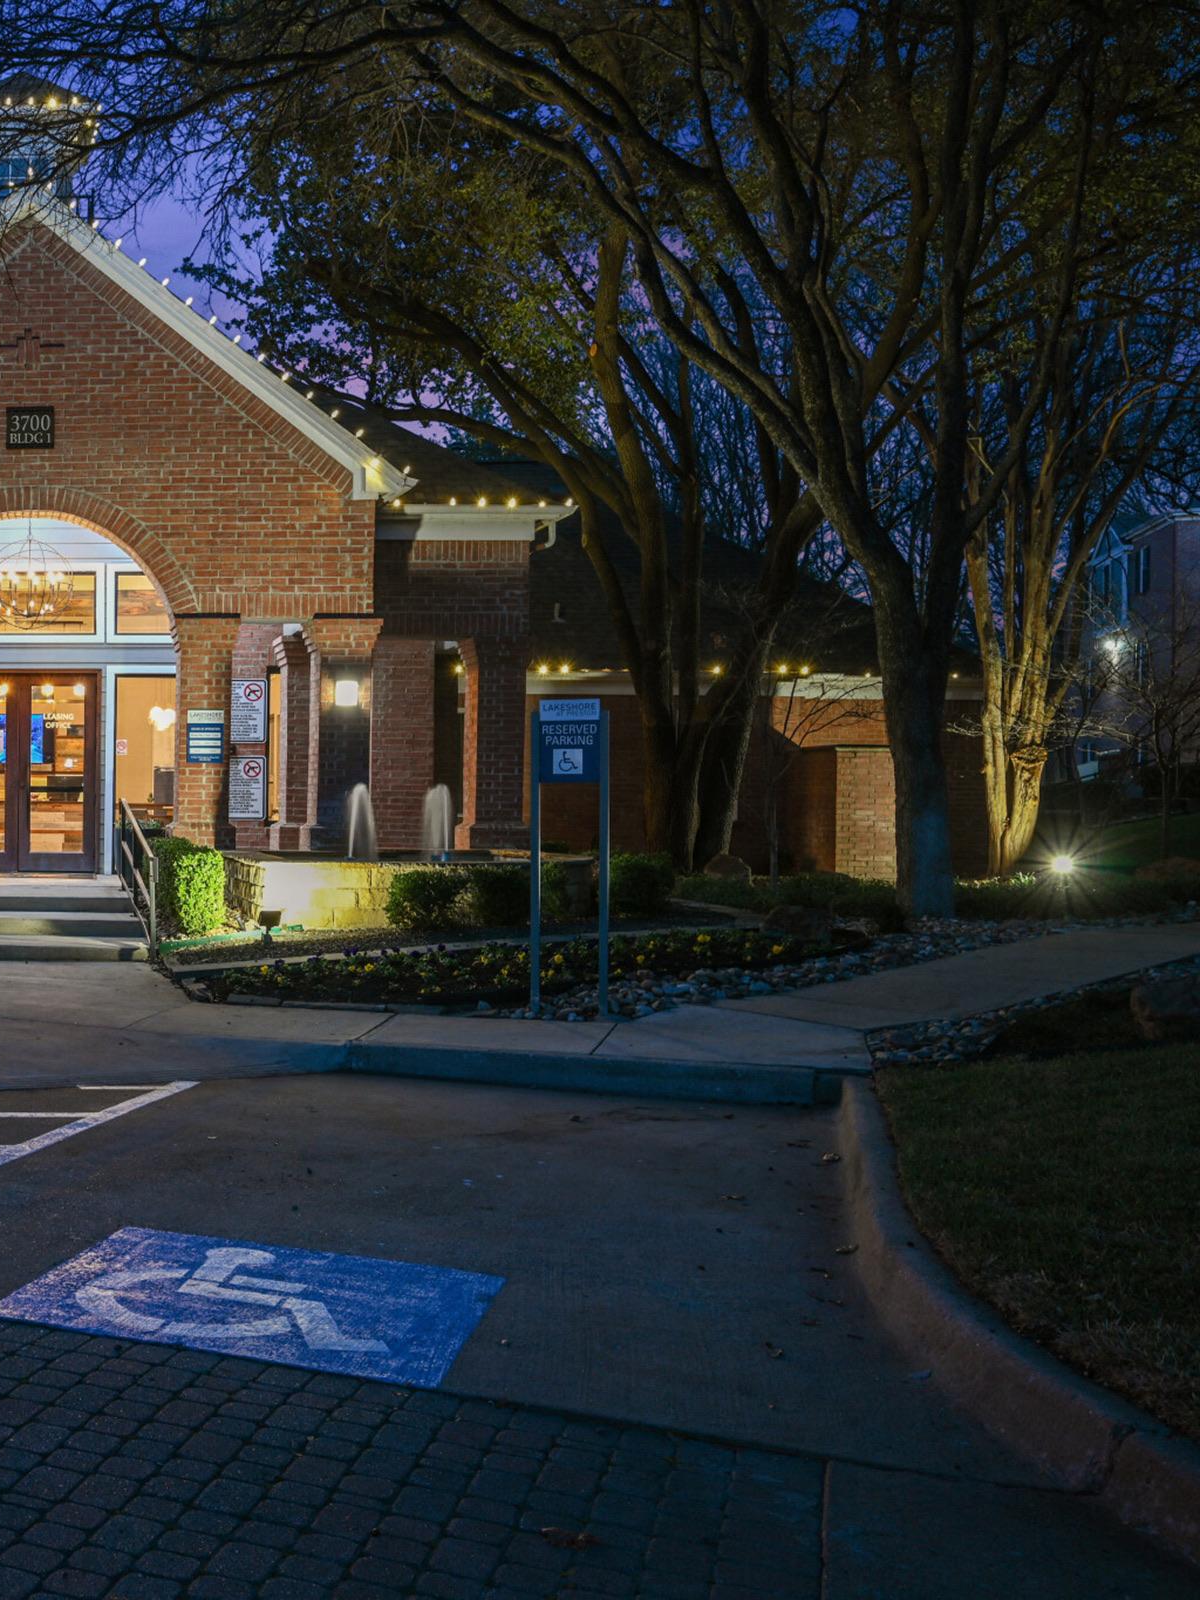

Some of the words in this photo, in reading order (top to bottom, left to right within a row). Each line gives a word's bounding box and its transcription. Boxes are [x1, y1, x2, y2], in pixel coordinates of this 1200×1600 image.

[10, 414, 51, 432] 3700
[9, 432, 43, 444] BLDG
[46, 432, 51, 444] 1
[542, 702, 597, 712] LAKESHORE
[43, 712, 75, 721] LEASING
[45, 721, 72, 729] OFFICE
[541, 723, 598, 735] RESERVED
[545, 734, 594, 746] PARKING
